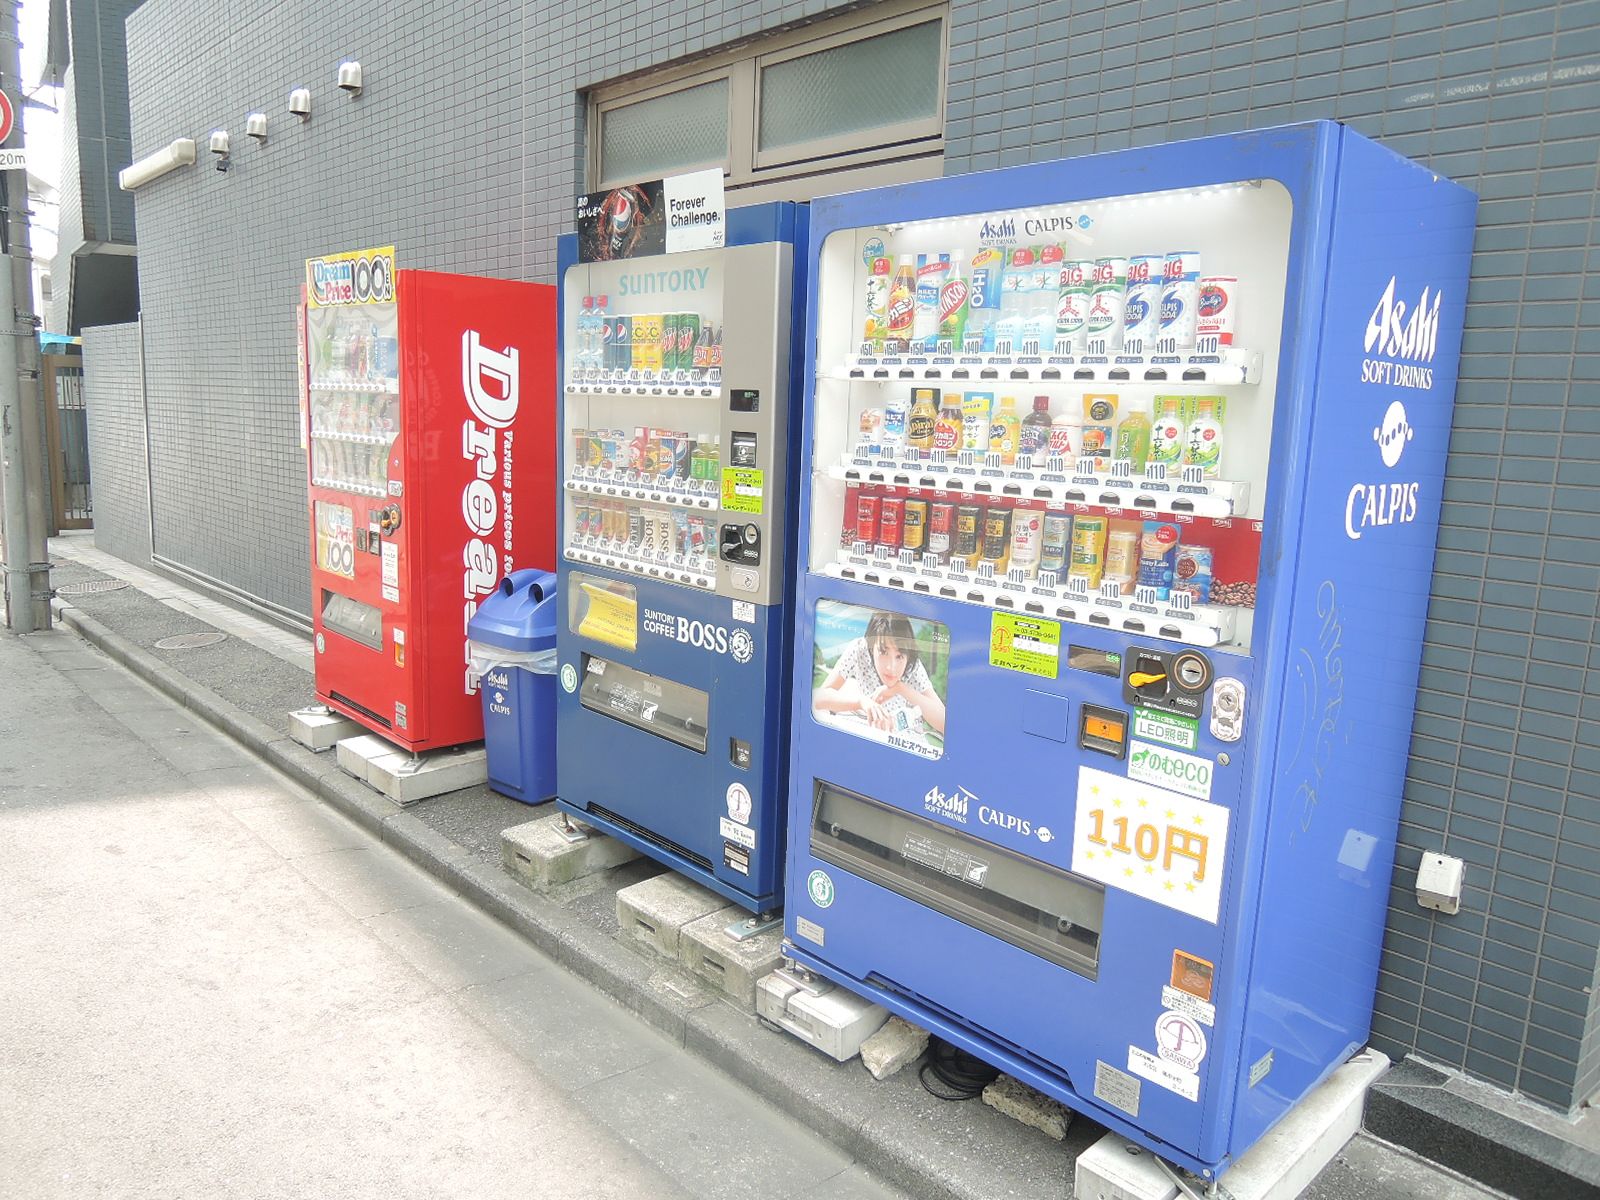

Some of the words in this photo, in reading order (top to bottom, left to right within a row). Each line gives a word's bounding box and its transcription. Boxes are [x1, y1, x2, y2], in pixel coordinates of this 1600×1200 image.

[670, 196, 706, 212] Forever
[671, 211, 721, 228] Challenge.
[980, 217, 1015, 239] Asahi
[1025, 216, 1073, 236] CALPIS
[316, 262, 351, 281] Dream
[351, 259, 384, 301] 100
[619, 267, 709, 296] SUNTORY
[1060, 268, 1083, 284] BIG
[1092, 265, 1113, 282] BIG
[1128, 262, 1149, 280] BIG
[325, 282, 351, 301] Price
[1364, 275, 1442, 363] Asahi
[1361, 359, 1393, 385] SOFT
[1393, 364, 1433, 390] DRINKS
[911, 419, 934, 430] piral
[503, 430, 514, 489] Various
[502, 490, 513, 551] prices
[1345, 482, 1419, 540] CALPIS
[646, 519, 654, 551] BOSS
[660, 522, 669, 553] BOSS
[328, 541, 354, 575] 100
[503, 554, 513, 577] fo
[644, 608, 675, 625] SUNTORY
[643, 620, 675, 638] COFFEE
[676, 616, 728, 654] BOSS
[488, 671, 508, 685] Asahi
[489, 703, 510, 716] CALPIS
[1139, 721, 1189, 745] LED照明
[887, 733, 943, 760] カルピスウォーター
[1149, 753, 1209, 785] のむeco
[924, 803, 941, 814] SOFT
[942, 809, 967, 824] DRINKS
[925, 785, 969, 816] Asahi
[978, 805, 1031, 836] CALPIS
[1088, 808, 1209, 883] 110円
